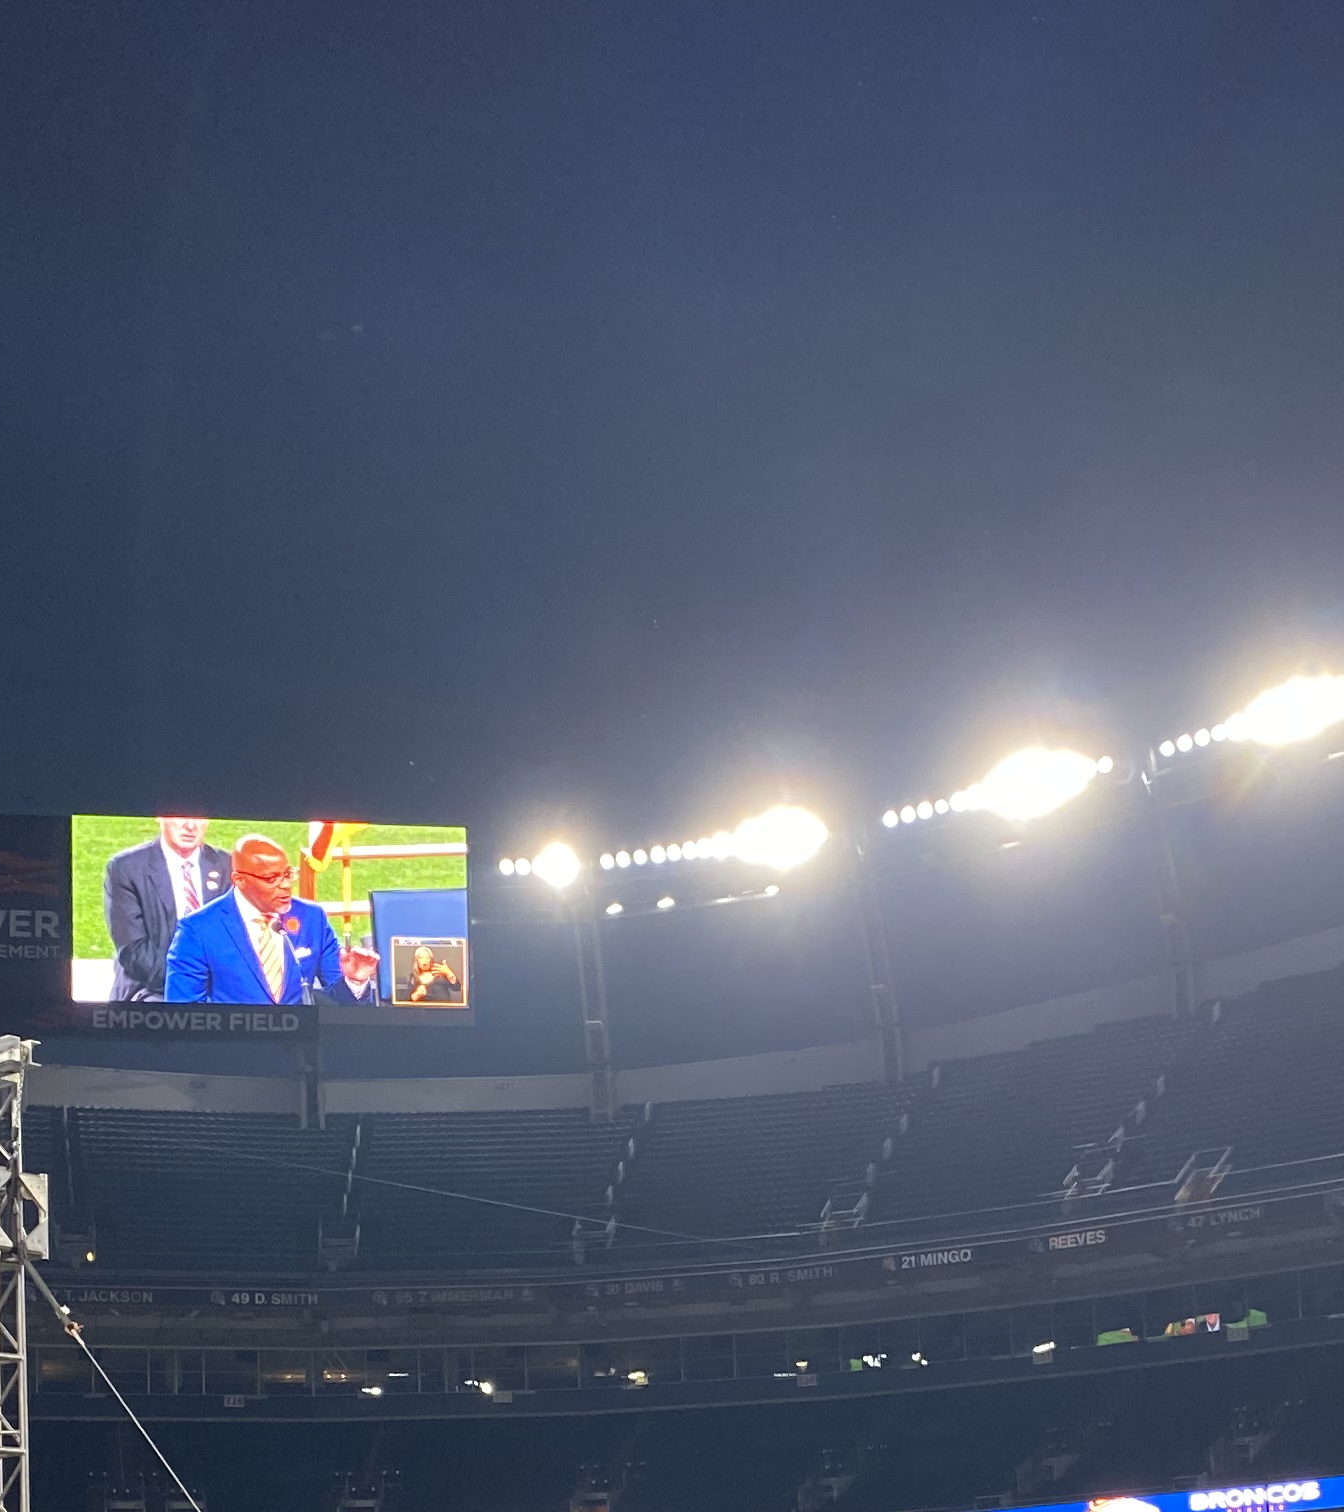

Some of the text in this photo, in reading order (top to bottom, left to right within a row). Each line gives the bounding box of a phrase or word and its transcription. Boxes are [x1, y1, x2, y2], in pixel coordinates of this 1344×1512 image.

[92, 1009, 299, 1033] EMPOWER FIELD
[1210, 1207, 1261, 1226] LYNCH
[1048, 1229, 1106, 1250] REEVES
[901, 1249, 972, 1269] 21 MINGO
[787, 1266, 833, 1282] SMITH
[78, 1290, 152, 1304] JACKSON
[624, 1281, 664, 1294] DAVIS
[231, 1292, 318, 1304] 49 D. SMITH
[1189, 1481, 1320, 1511] BRONCOS
